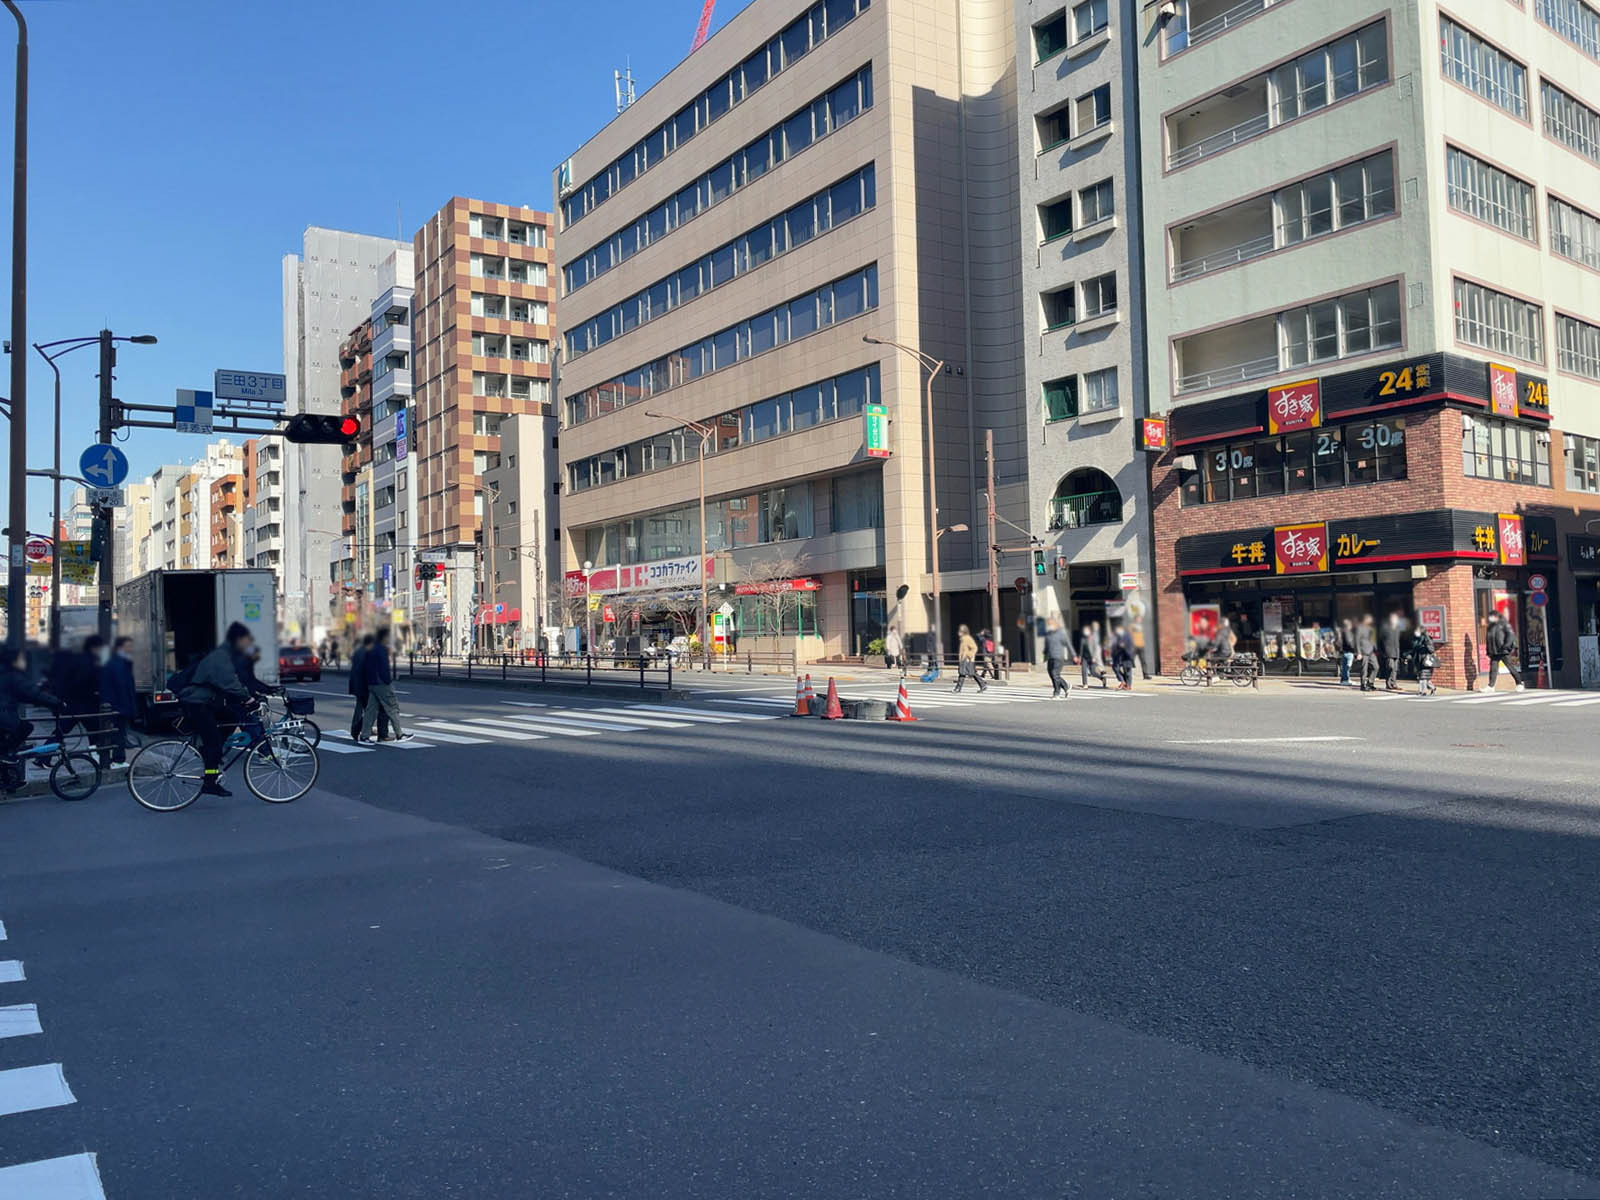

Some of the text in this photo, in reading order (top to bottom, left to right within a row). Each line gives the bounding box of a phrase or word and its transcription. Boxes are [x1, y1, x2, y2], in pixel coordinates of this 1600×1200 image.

[221, 374, 283, 389] 三田3丁目
[1379, 367, 1412, 396] 24
[1493, 370, 1515, 402] すき家
[1274, 390, 1314, 418] すき家
[1317, 436, 1338, 455] 2F
[1281, 531, 1321, 561] すき家
[1337, 533, 1380, 557] カレー
[1475, 525, 1495, 550] 牛丼
[1503, 520, 1522, 549] すき家
[1232, 541, 1265, 564] 牛丼
[650, 560, 698, 578] ココカラファイン
